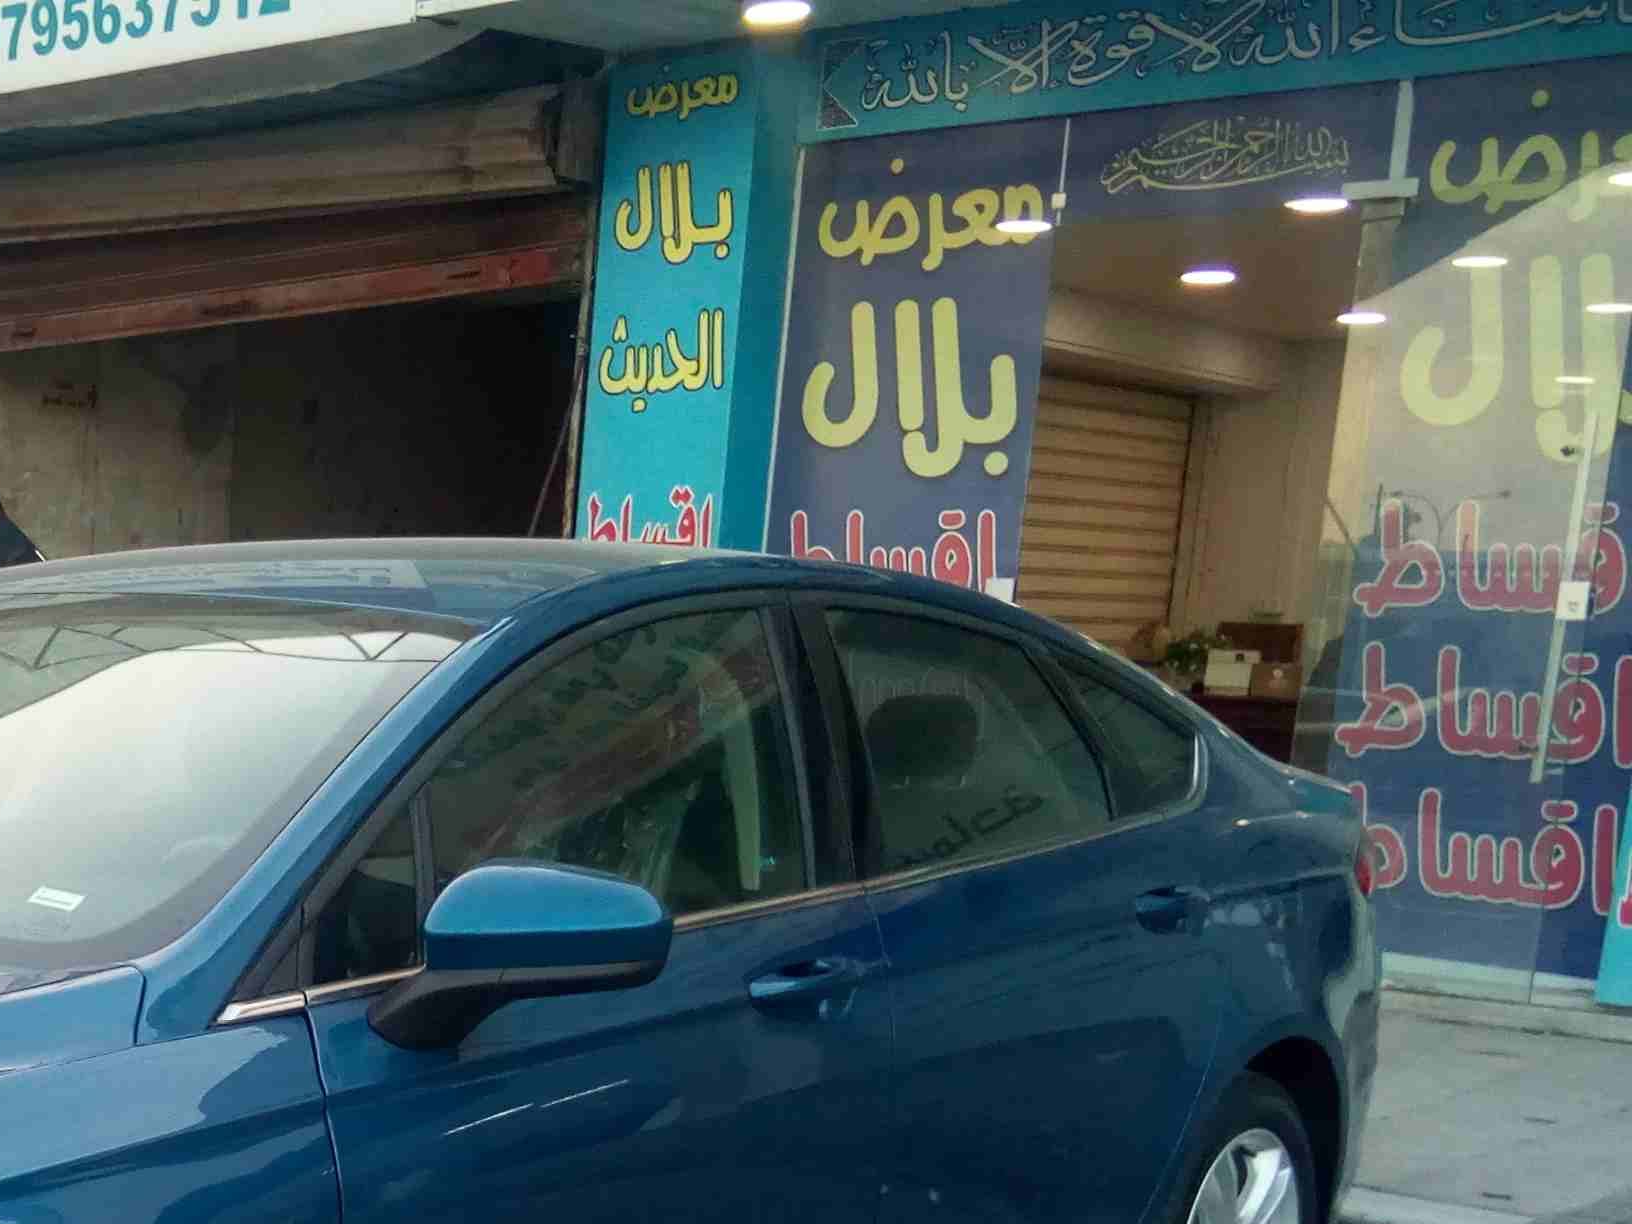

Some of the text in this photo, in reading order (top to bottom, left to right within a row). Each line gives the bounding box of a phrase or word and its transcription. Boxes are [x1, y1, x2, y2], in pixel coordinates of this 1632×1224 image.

[626, 64, 739, 121] معرض
[615, 161, 734, 264] بلال
[818, 157, 1044, 271] معرض
[598, 308, 725, 413] الحديث
[801, 297, 1018, 478] بلال
[1400, 252, 1632, 463] لال
[1353, 498, 1626, 617] قساط
